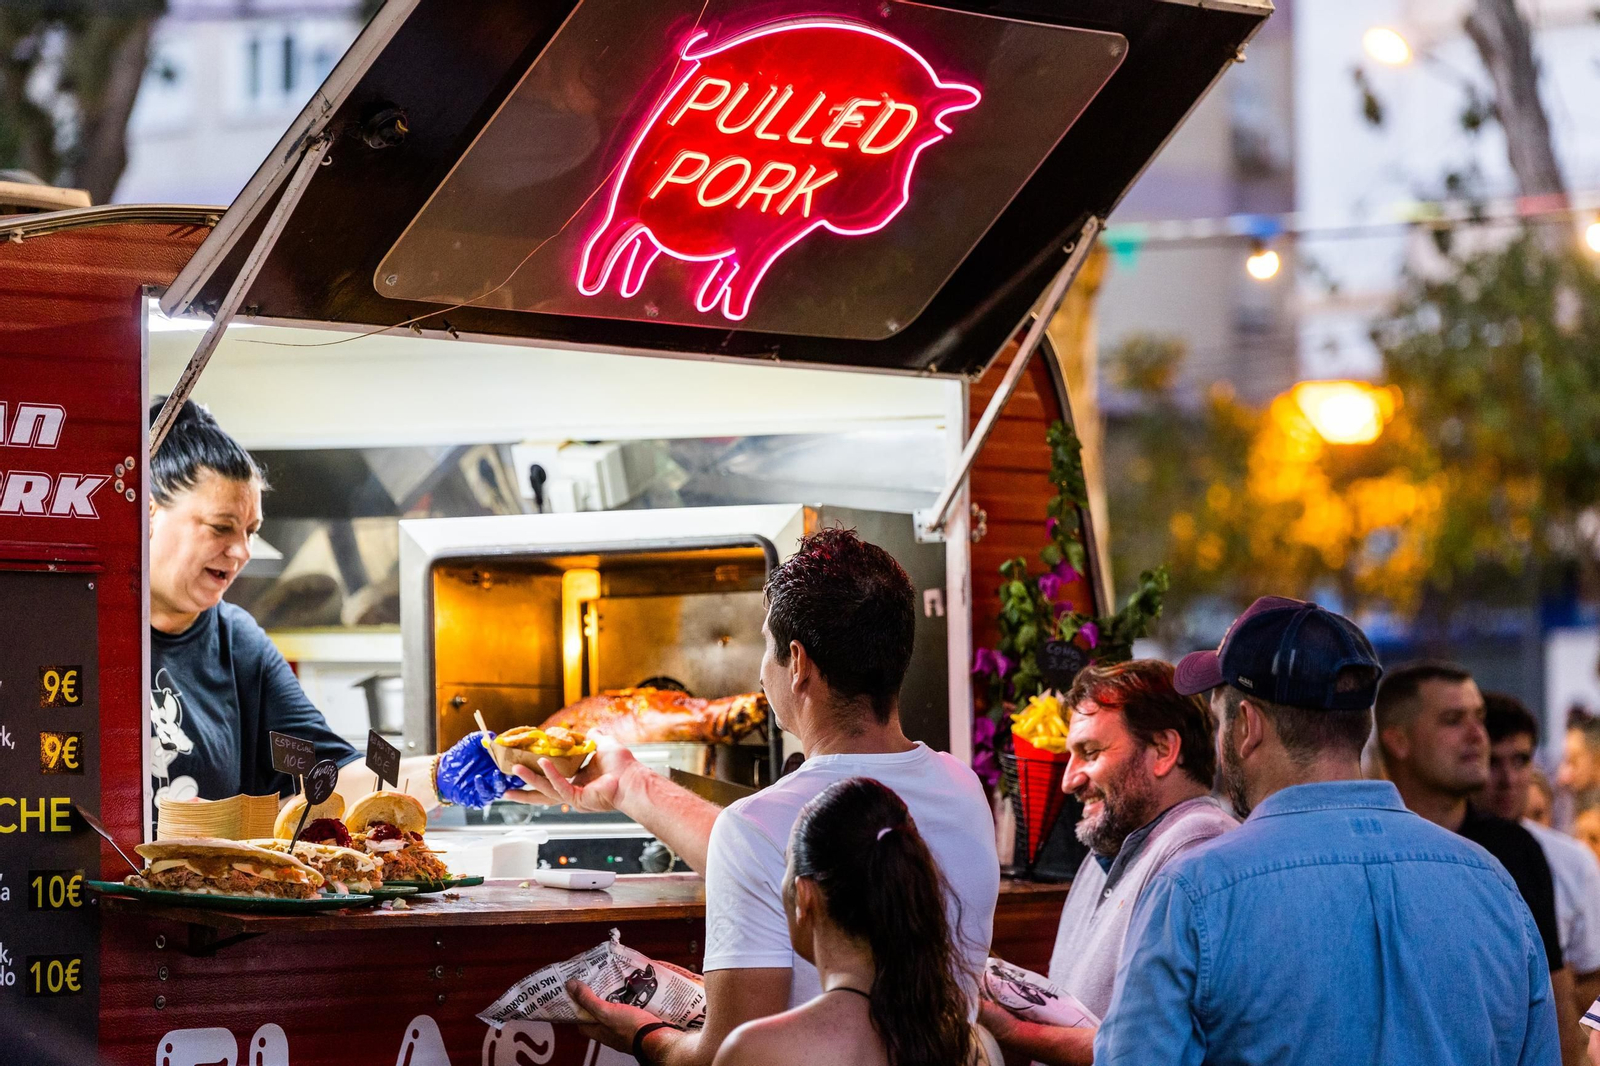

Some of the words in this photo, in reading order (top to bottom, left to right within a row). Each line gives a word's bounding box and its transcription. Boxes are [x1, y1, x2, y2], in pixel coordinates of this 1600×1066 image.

[667, 75, 919, 155] PULLED
[648, 149, 839, 218] PORK
[0, 470, 112, 519] RK
[43, 670, 79, 703] 9€
[44, 736, 79, 769] 9€
[31, 875, 83, 908] 10€
[29, 958, 82, 993] 10€
[527, 983, 541, 996] NO
[540, 975, 558, 988] HAS
[536, 986, 563, 1006] LIVING
[690, 993, 704, 1010] The
